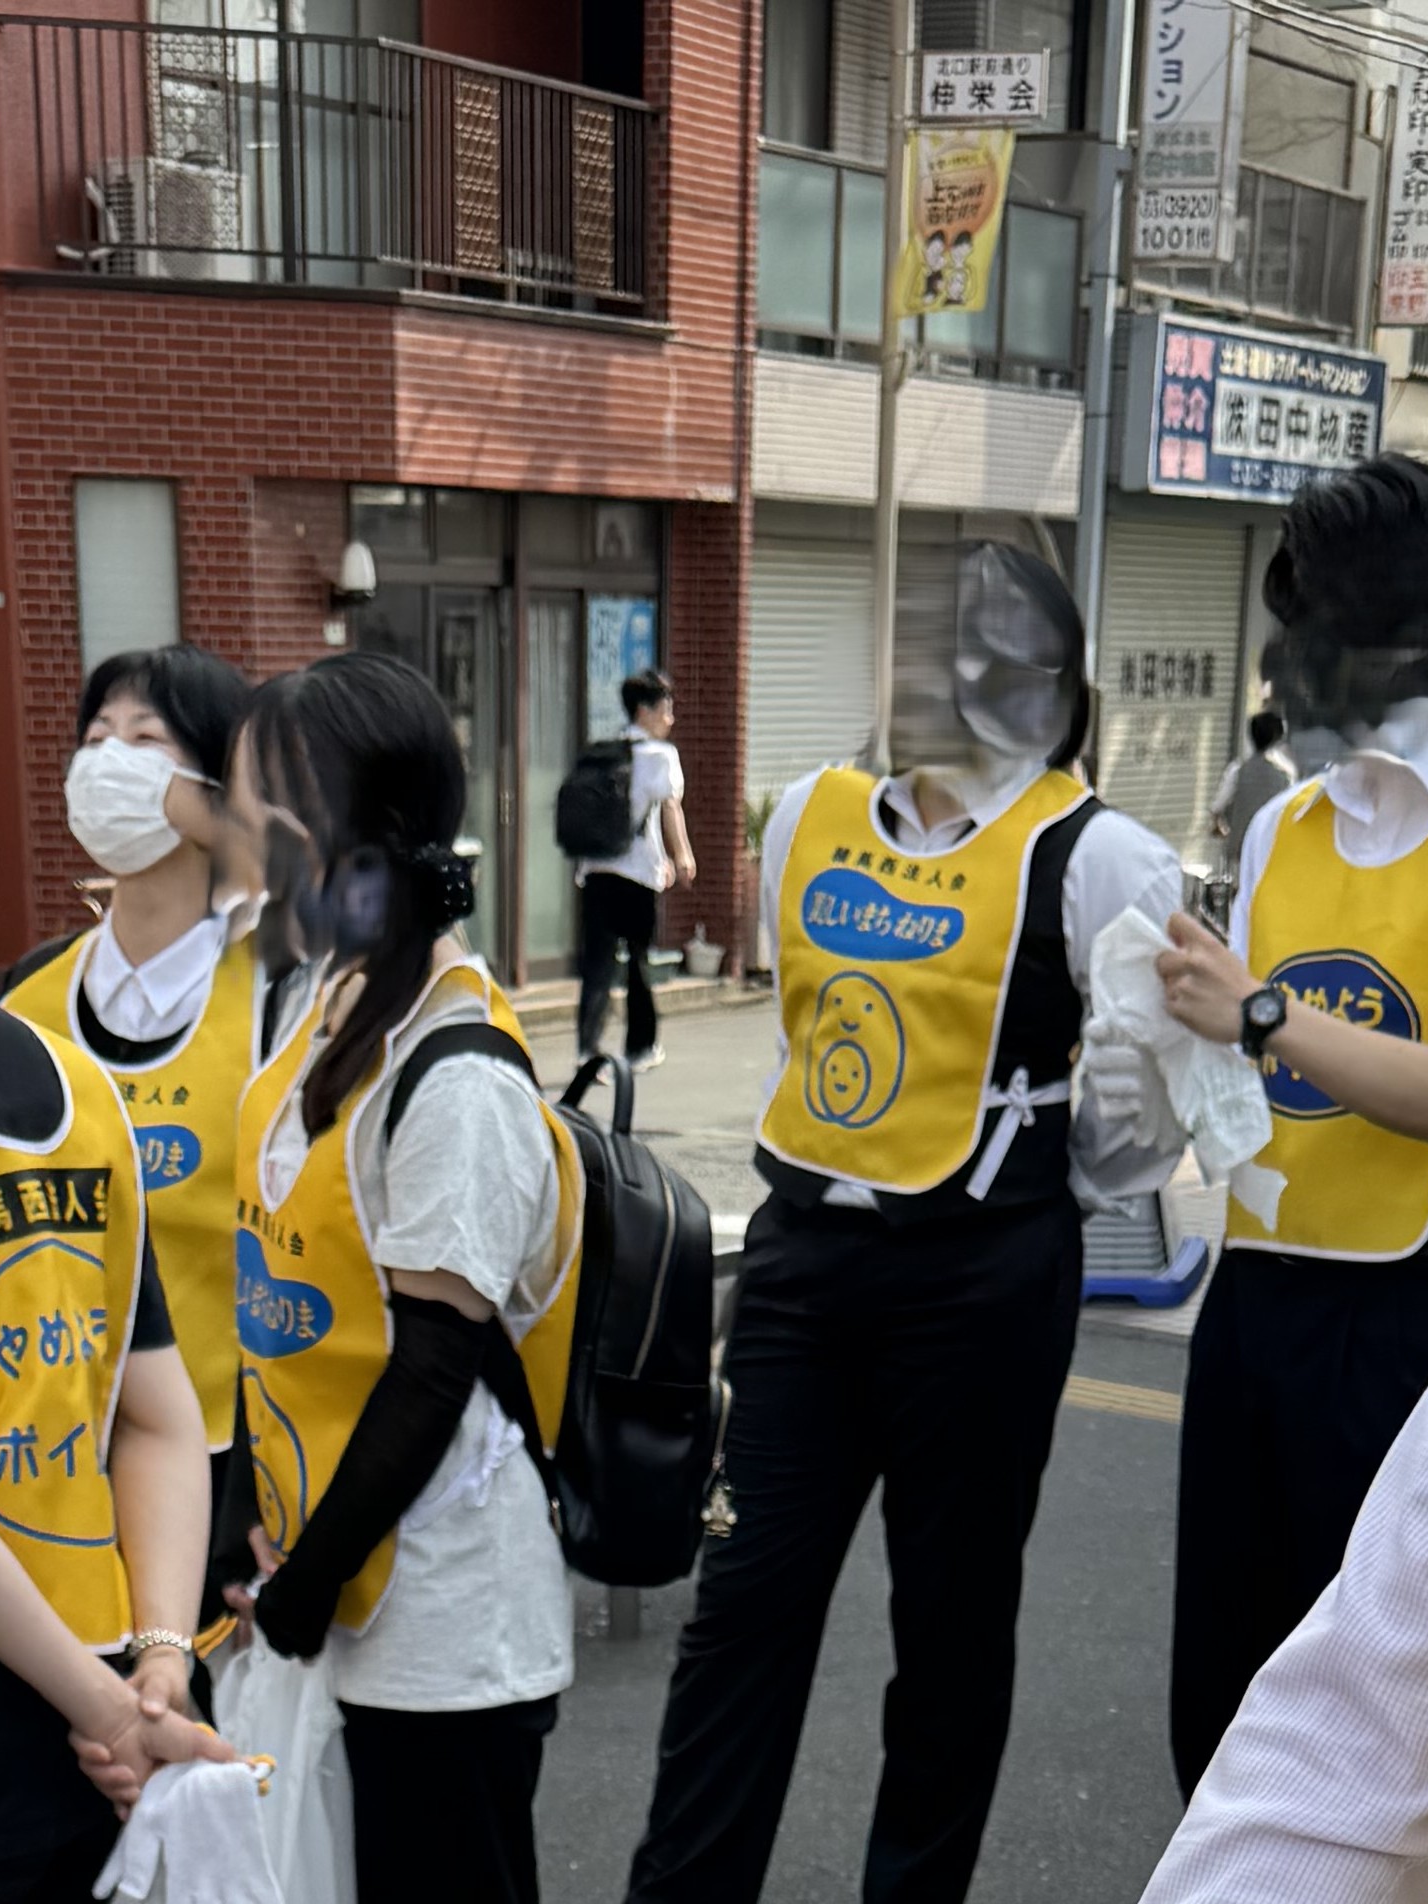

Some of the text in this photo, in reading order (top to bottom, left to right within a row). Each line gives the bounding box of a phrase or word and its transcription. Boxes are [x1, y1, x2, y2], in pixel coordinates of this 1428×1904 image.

[1154, 0, 1184, 119] ション
[138, 1138, 185, 1178] りま
